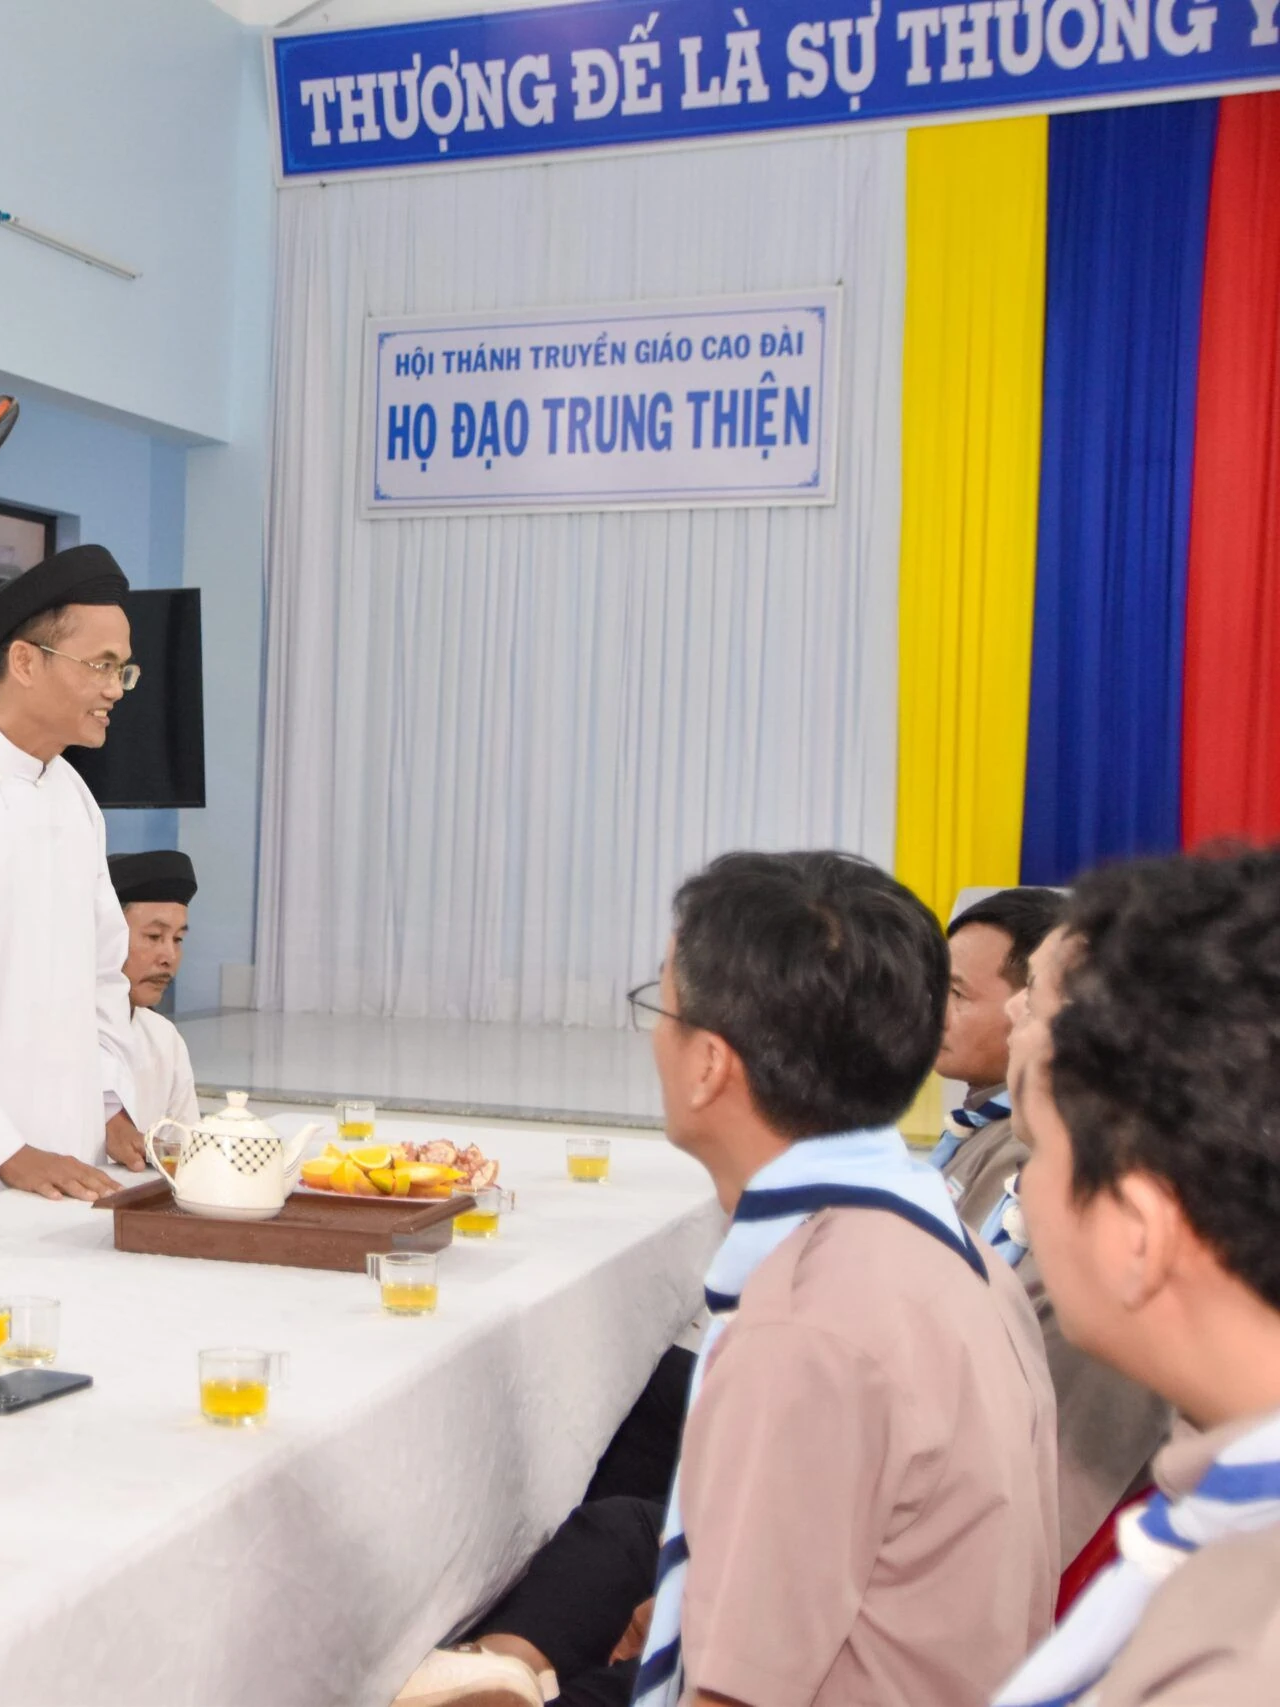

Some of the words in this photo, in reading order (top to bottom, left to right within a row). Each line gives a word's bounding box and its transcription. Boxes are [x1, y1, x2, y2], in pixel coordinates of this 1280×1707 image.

[300, 49, 557, 152] THƯỢNG
[570, 12, 663, 121] ĐẾ
[678, 7, 770, 110] LÀ
[786, 0, 882, 111] SỰ
[395, 346, 435, 381] HỘI
[441, 342, 521, 374] THÁNH
[634, 332, 693, 364] GIÁO
[701, 334, 751, 361] CAO
[759, 325, 804, 358] ĐÀI
[386, 402, 438, 473] HỌ
[450, 399, 530, 471] ĐẠO
[542, 392, 673, 455] TRUNG
[686, 370, 811, 460] THIỆN
